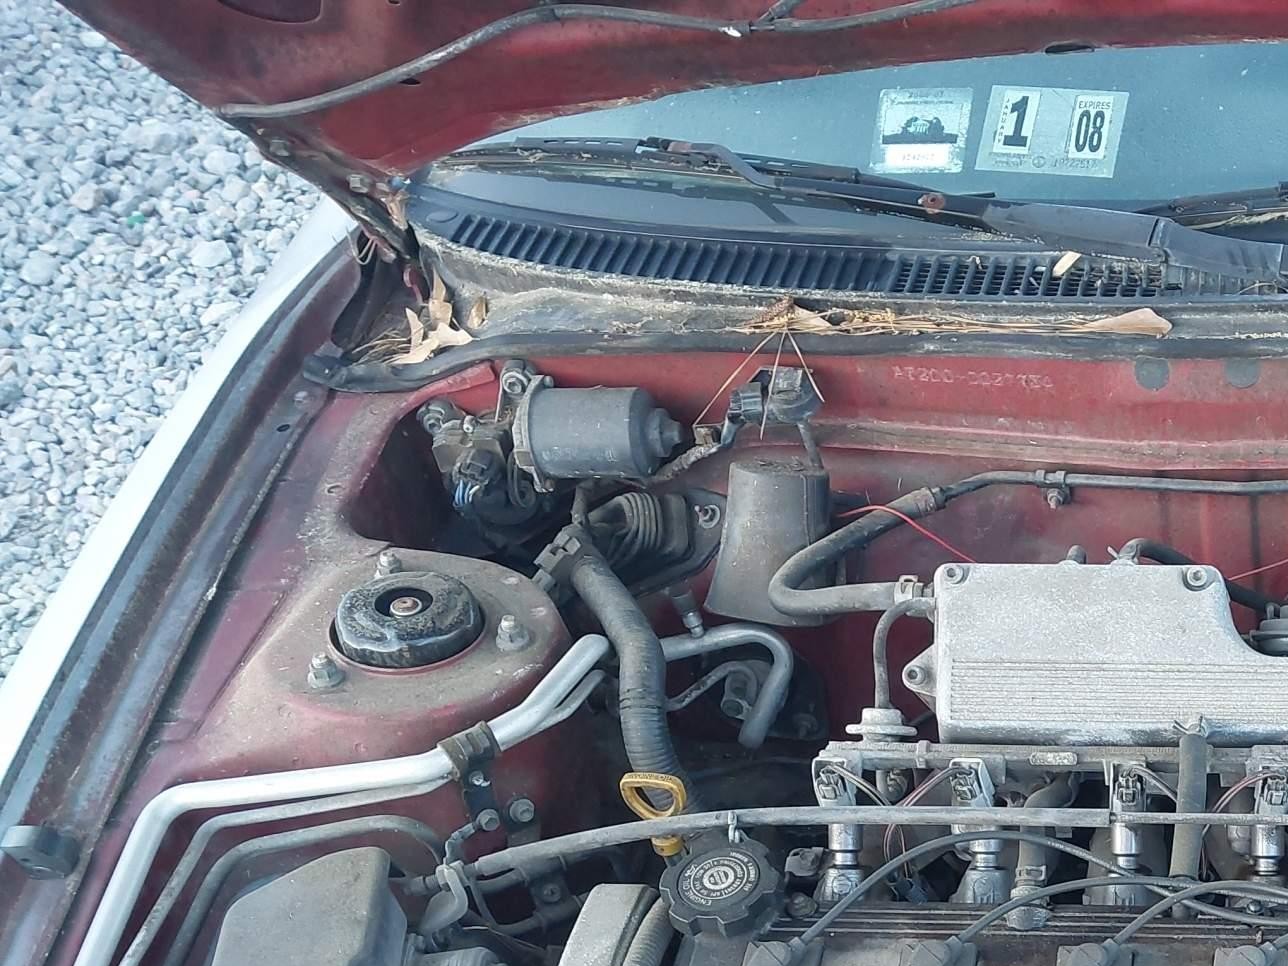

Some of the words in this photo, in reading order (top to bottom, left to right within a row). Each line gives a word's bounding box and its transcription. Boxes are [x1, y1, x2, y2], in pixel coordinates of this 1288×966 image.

[1002, 95, 1030, 148] 1
[1078, 100, 1112, 110] EXPIRES
[1074, 110, 1106, 153] 08
